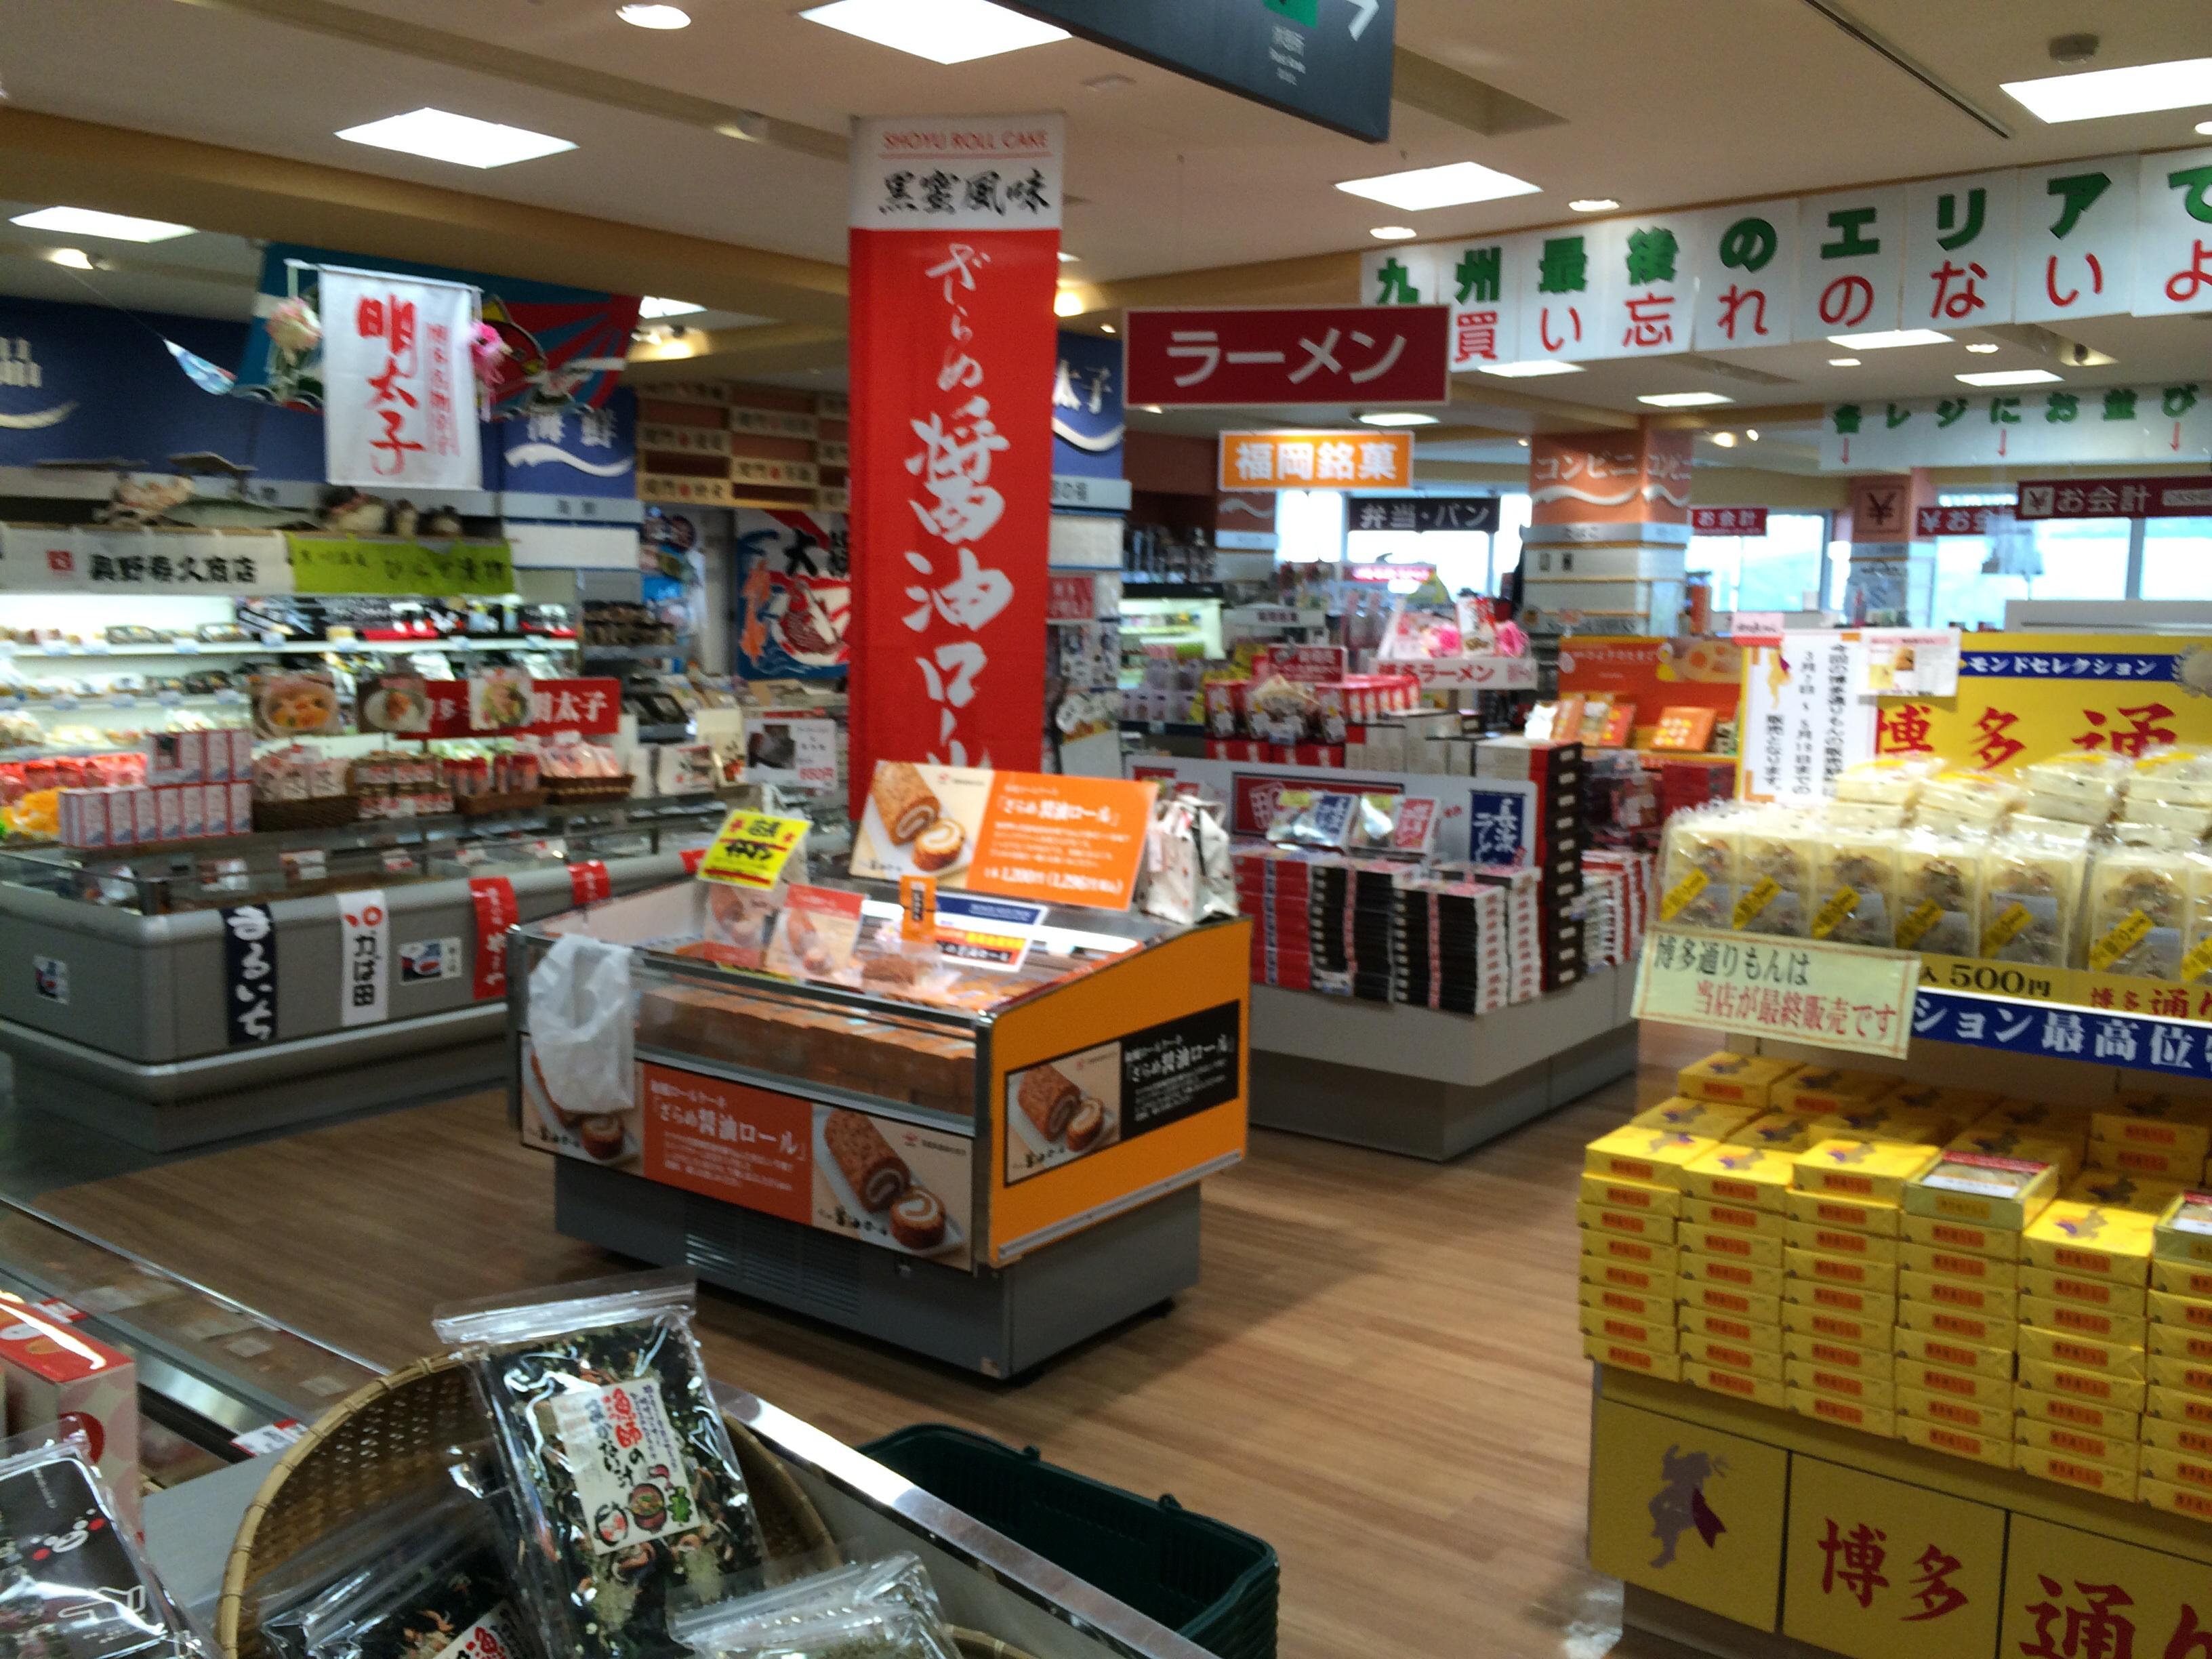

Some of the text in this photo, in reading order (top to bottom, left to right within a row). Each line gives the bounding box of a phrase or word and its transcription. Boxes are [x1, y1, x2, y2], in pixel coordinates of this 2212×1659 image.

[883, 131, 1049, 150] SHOYU ROLL CAKE
[1166, 327, 1407, 388] ラーメン
[356, 293, 424, 476] 明太子
[1235, 442, 1399, 482] 福岡銘菓
[1534, 451, 1639, 481] コンビニ
[1359, 502, 1489, 529] 弁当・パン
[1868, 491, 1896, 526] ¥
[2057, 485, 2151, 514] お会計
[1698, 510, 1756, 527] お会計
[1968, 655, 2157, 678] モンドセレクション
[1876, 701, 2178, 771] 博多通
[1654, 935, 1810, 985] 博多通りもんは
[1949, 963, 2051, 998] 500円
[1695, 980, 1897, 1040] 当店が最終販売です
[1913, 996, 2212, 1071] ション最高位
